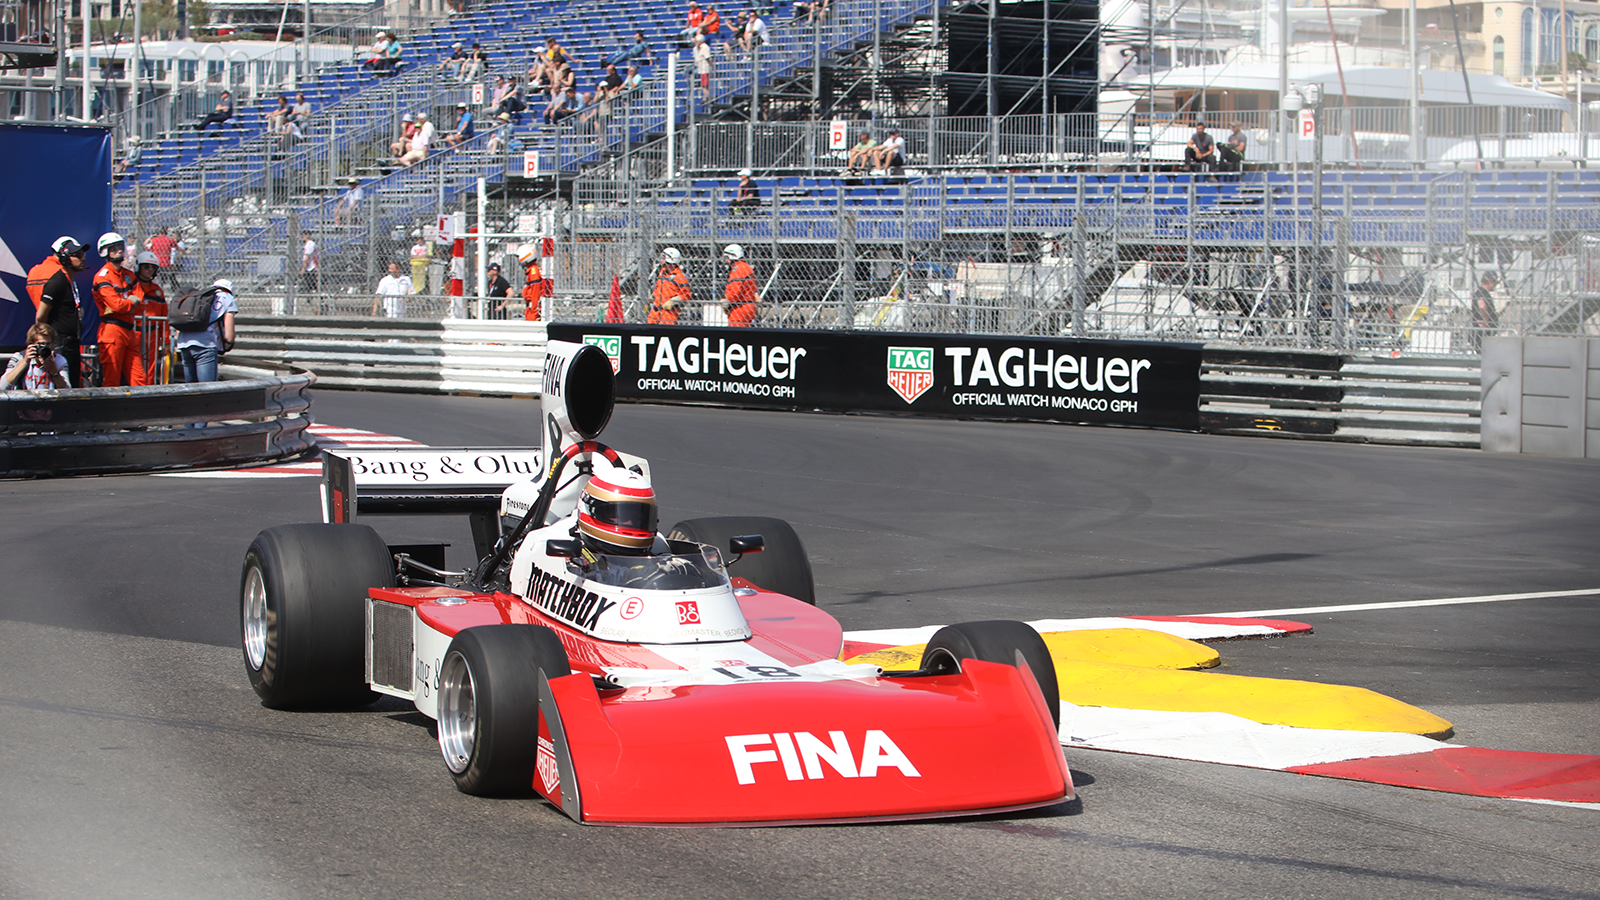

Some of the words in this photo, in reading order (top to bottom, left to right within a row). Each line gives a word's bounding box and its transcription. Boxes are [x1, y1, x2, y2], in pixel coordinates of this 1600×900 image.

[833, 131, 842, 145] P
[1303, 121, 1314, 136] P
[527, 161, 535, 174] P
[891, 350, 930, 369] TAG
[543, 353, 566, 397] FINA
[637, 378, 682, 391] OFFICIAL
[685, 379, 721, 392] WATCH
[722, 382, 770, 396] MONACO
[772, 386, 795, 398] GPH
[889, 371, 932, 400] HEUER
[952, 393, 1005, 406] OFFICIAL
[1007, 393, 1049, 408] WATCH
[1051, 396, 1108, 412] MONACO
[1110, 399, 1138, 413] GPH
[347, 456, 429, 482] Bang
[440, 456, 464, 474] &
[525, 562, 616, 631] MATCHBOX
[626, 601, 637, 615] E
[600, 627, 625, 638] BEOLAB
[669, 628, 721, 639] BEOMASTER
[712, 666, 801, 679] 18
[724, 729, 922, 785] FINA
